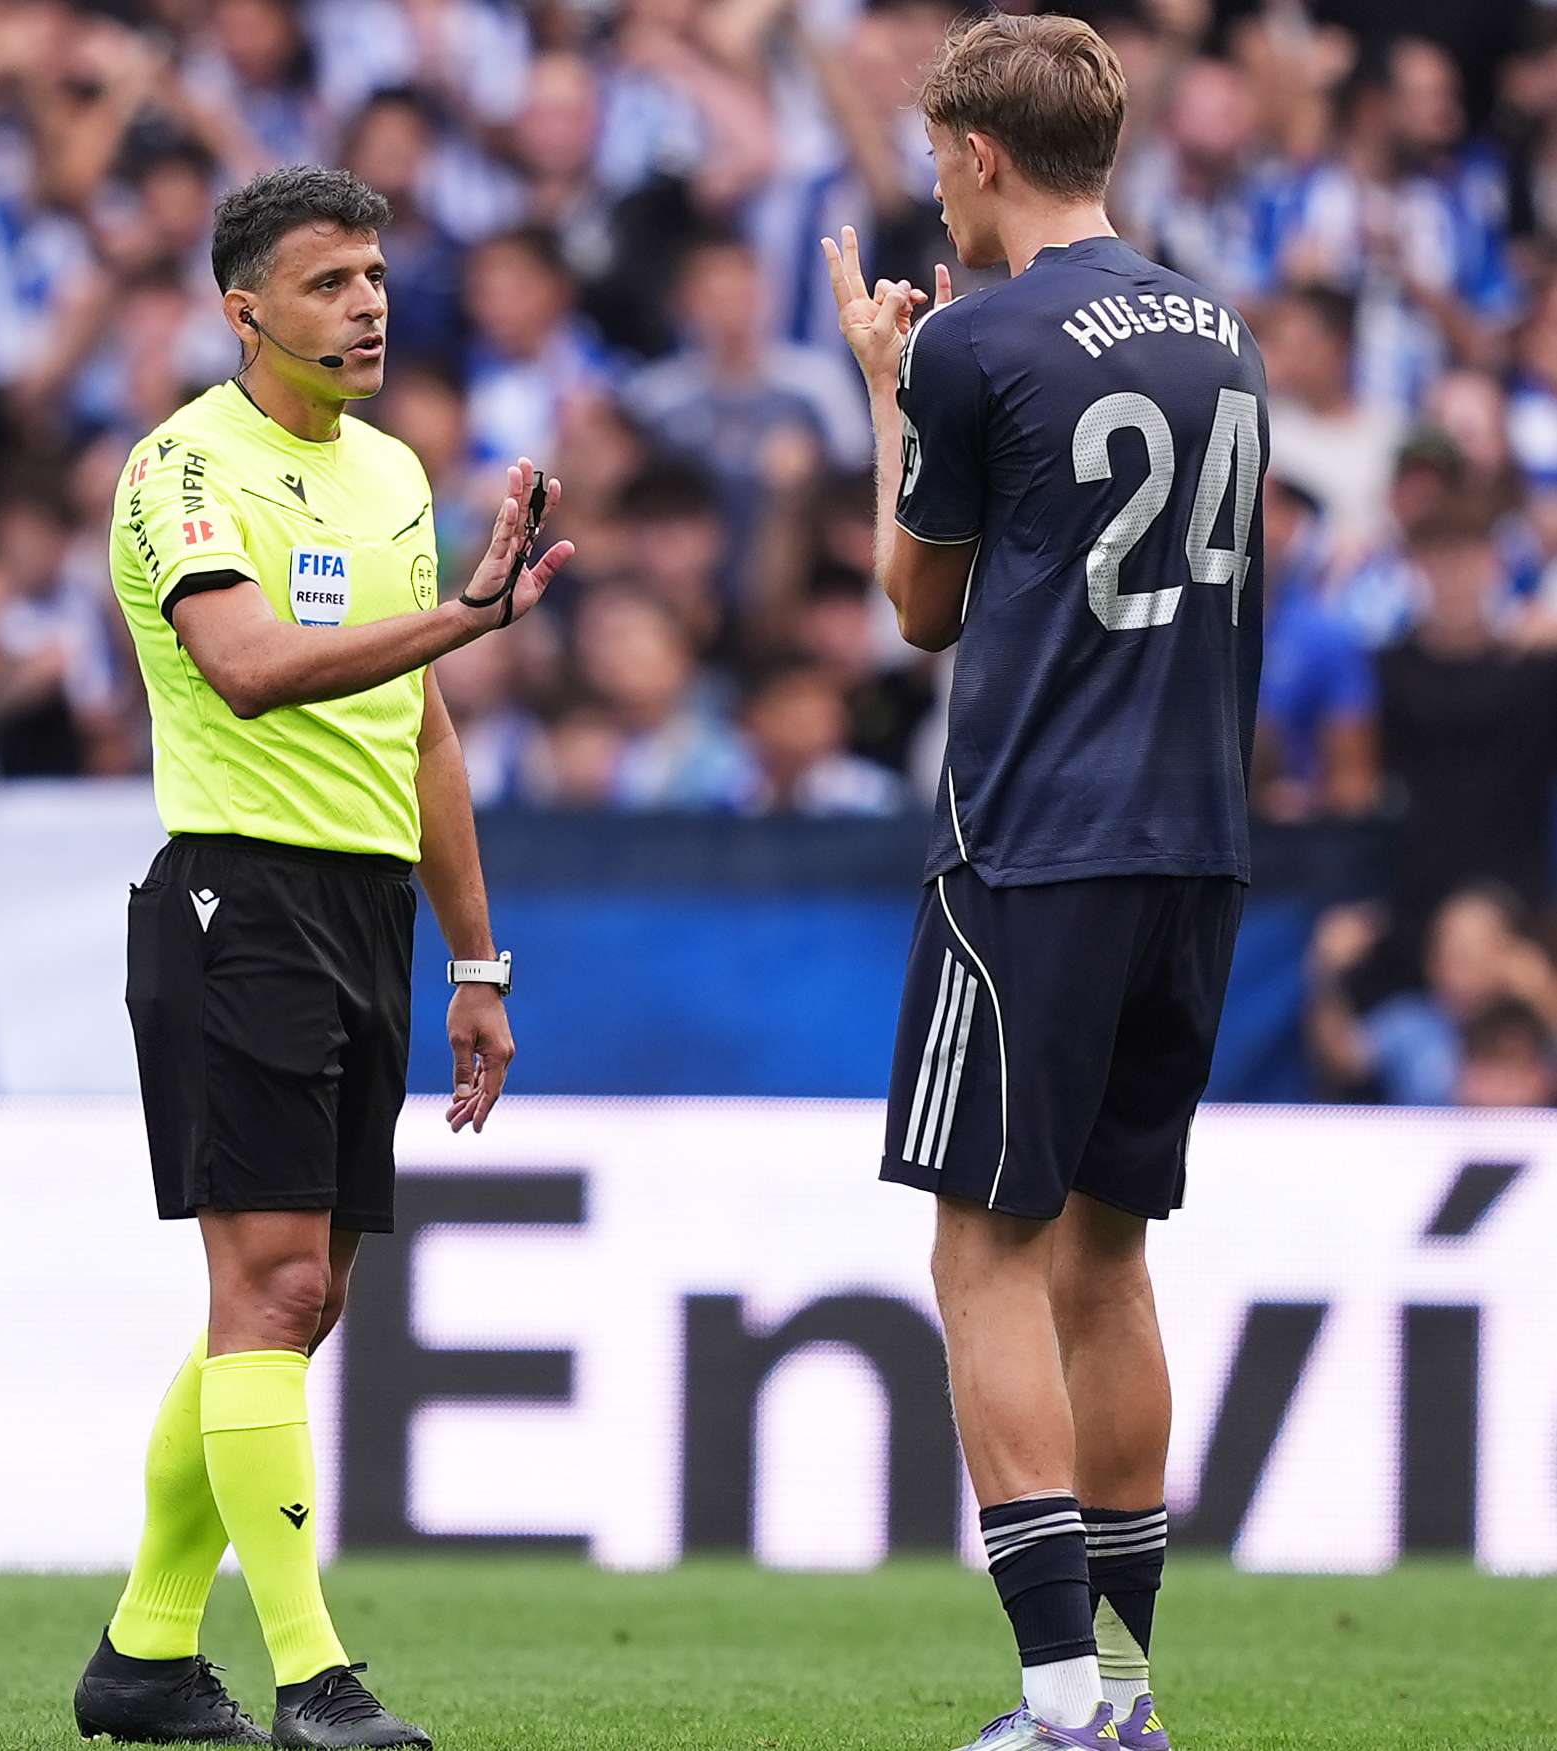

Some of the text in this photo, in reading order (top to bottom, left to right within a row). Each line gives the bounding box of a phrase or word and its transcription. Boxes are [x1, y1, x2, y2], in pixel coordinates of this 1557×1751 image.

[1062, 294, 1241, 359] HUIJSEN
[1072, 387, 1261, 632] 24
[299, 553, 345, 578] FIFA
[296, 590, 345, 606] REFEREE
